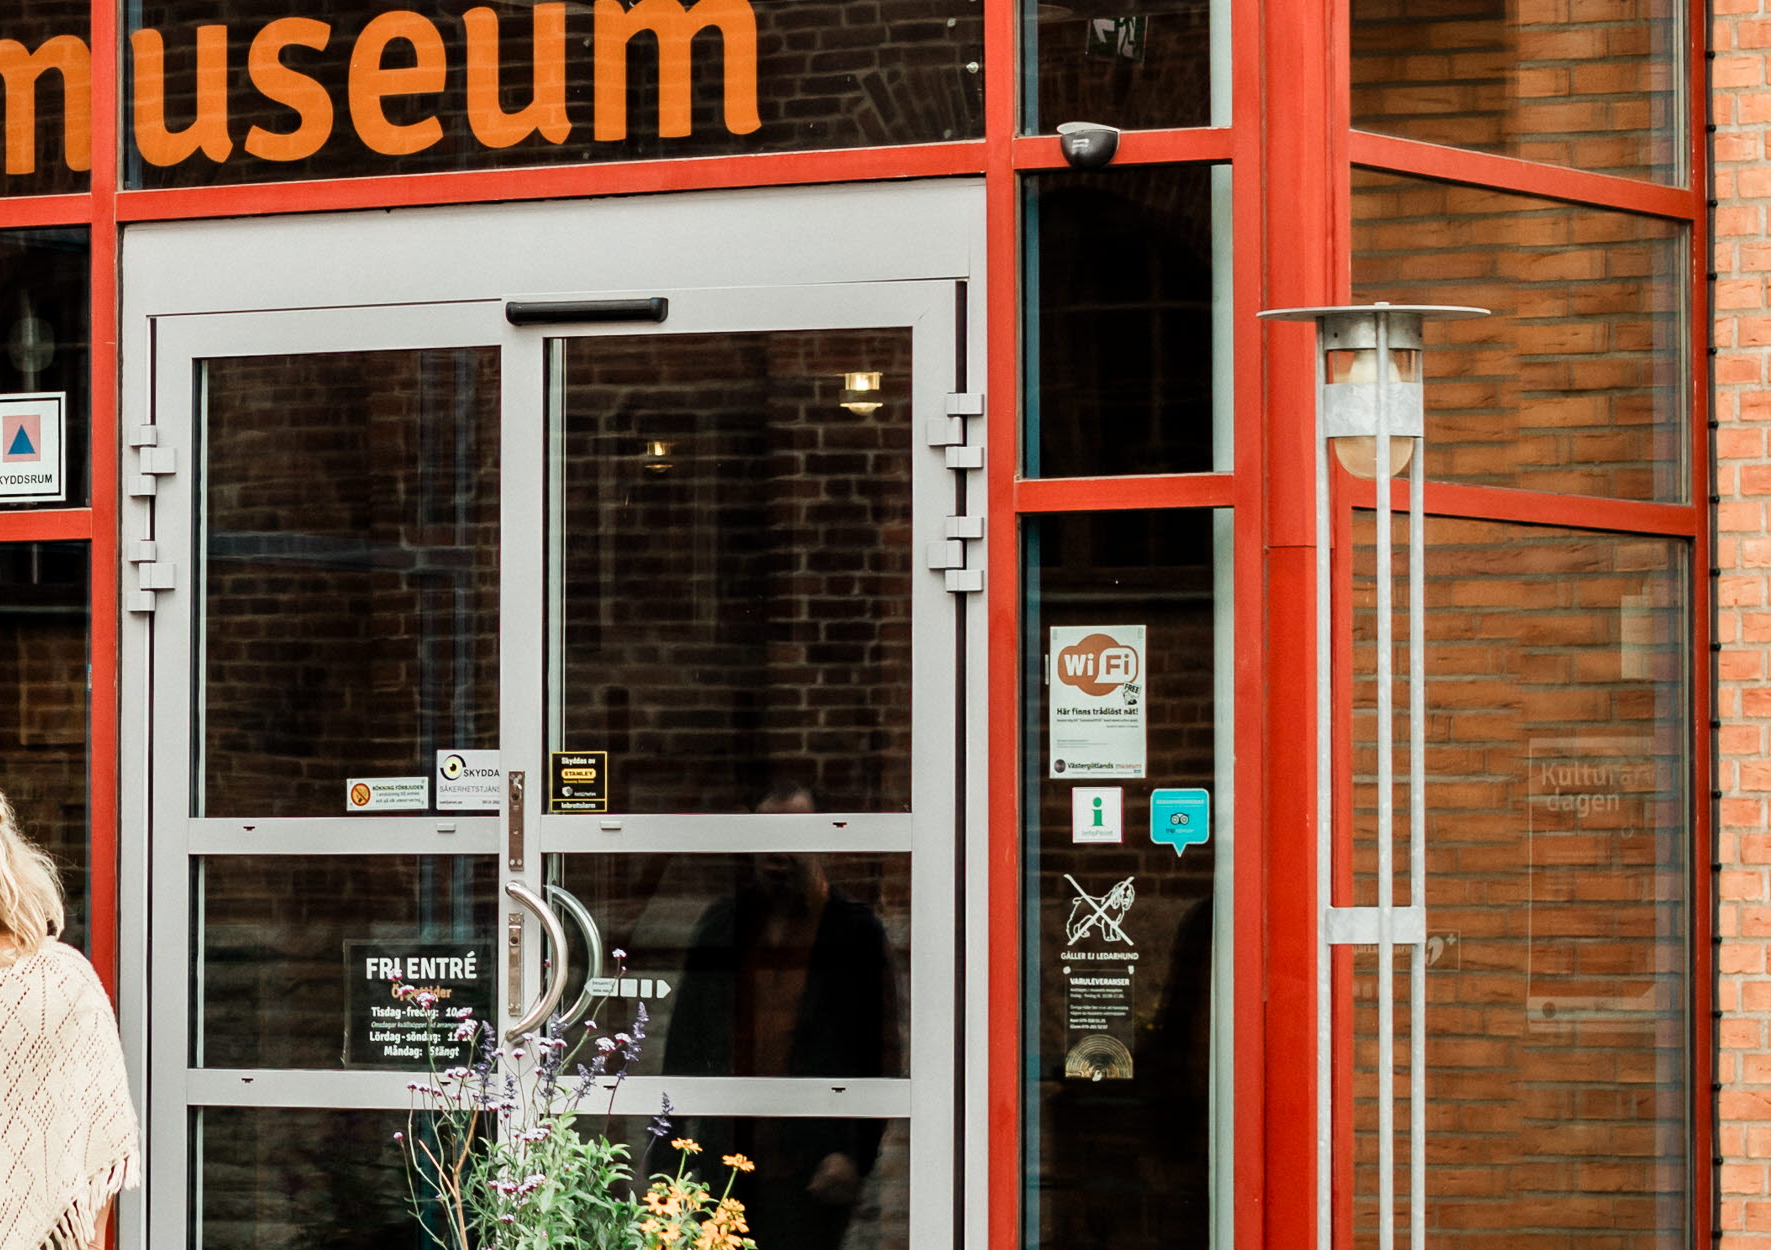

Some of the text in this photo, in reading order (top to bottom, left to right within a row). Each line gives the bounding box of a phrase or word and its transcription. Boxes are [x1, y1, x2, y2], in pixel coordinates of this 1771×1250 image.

[1124, 683, 1140, 694] FREE
[1057, 706, 1139, 715] Här finns trådlöst nät!
[1547, 787, 1620, 818] dagen
[1061, 951, 1140, 960] GÄLLER EJ LEDARHUND
[407, 950, 478, 979] ENTRÉ
[1069, 978, 1130, 986] VARULEVERANSER
[384, 1045, 460, 1059] Måndag: Stängt
